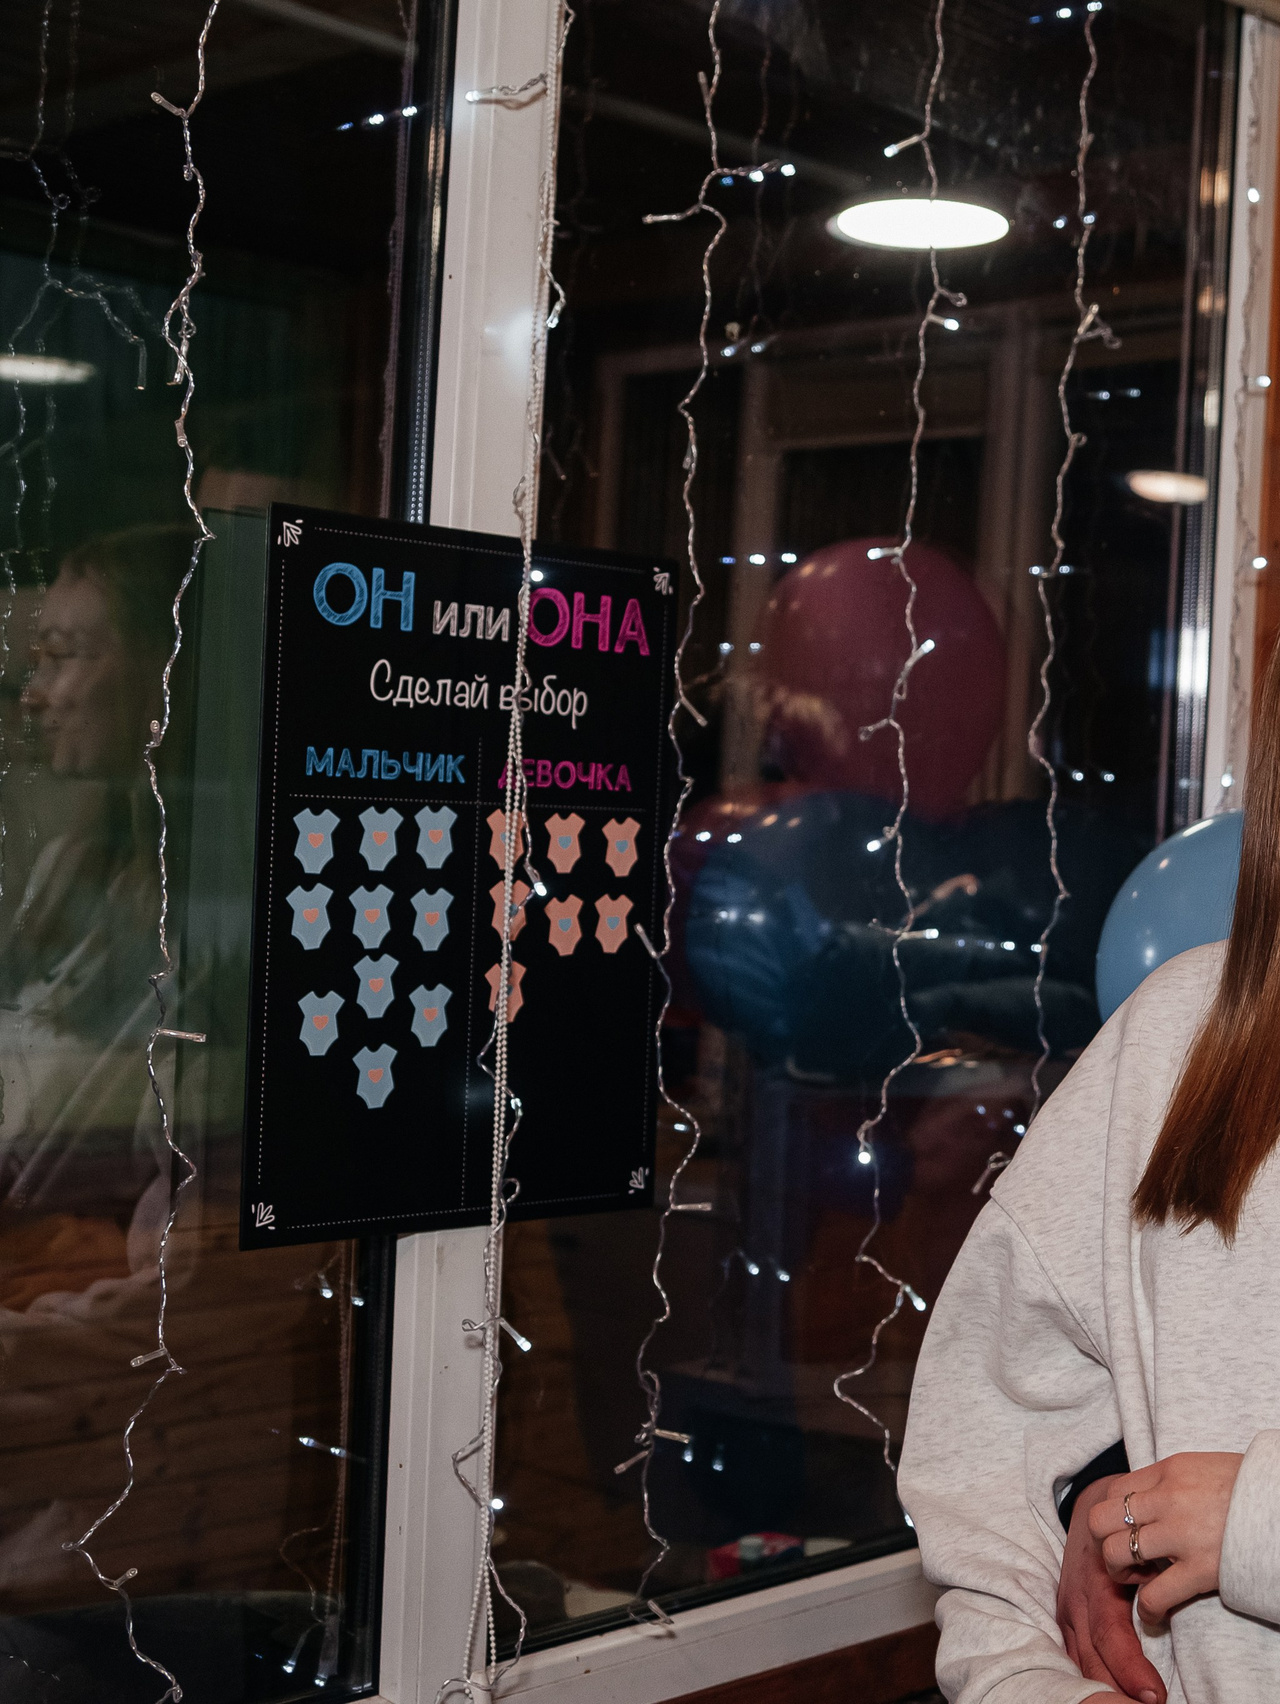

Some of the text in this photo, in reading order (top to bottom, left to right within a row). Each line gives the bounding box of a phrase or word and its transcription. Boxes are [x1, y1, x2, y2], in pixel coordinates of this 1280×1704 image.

[313, 562, 416, 632] ОН
[527, 587, 651, 657] ОНА
[369, 659, 589, 730] Сделай выбор
[305, 746, 466, 784] МАЛЬЧИК
